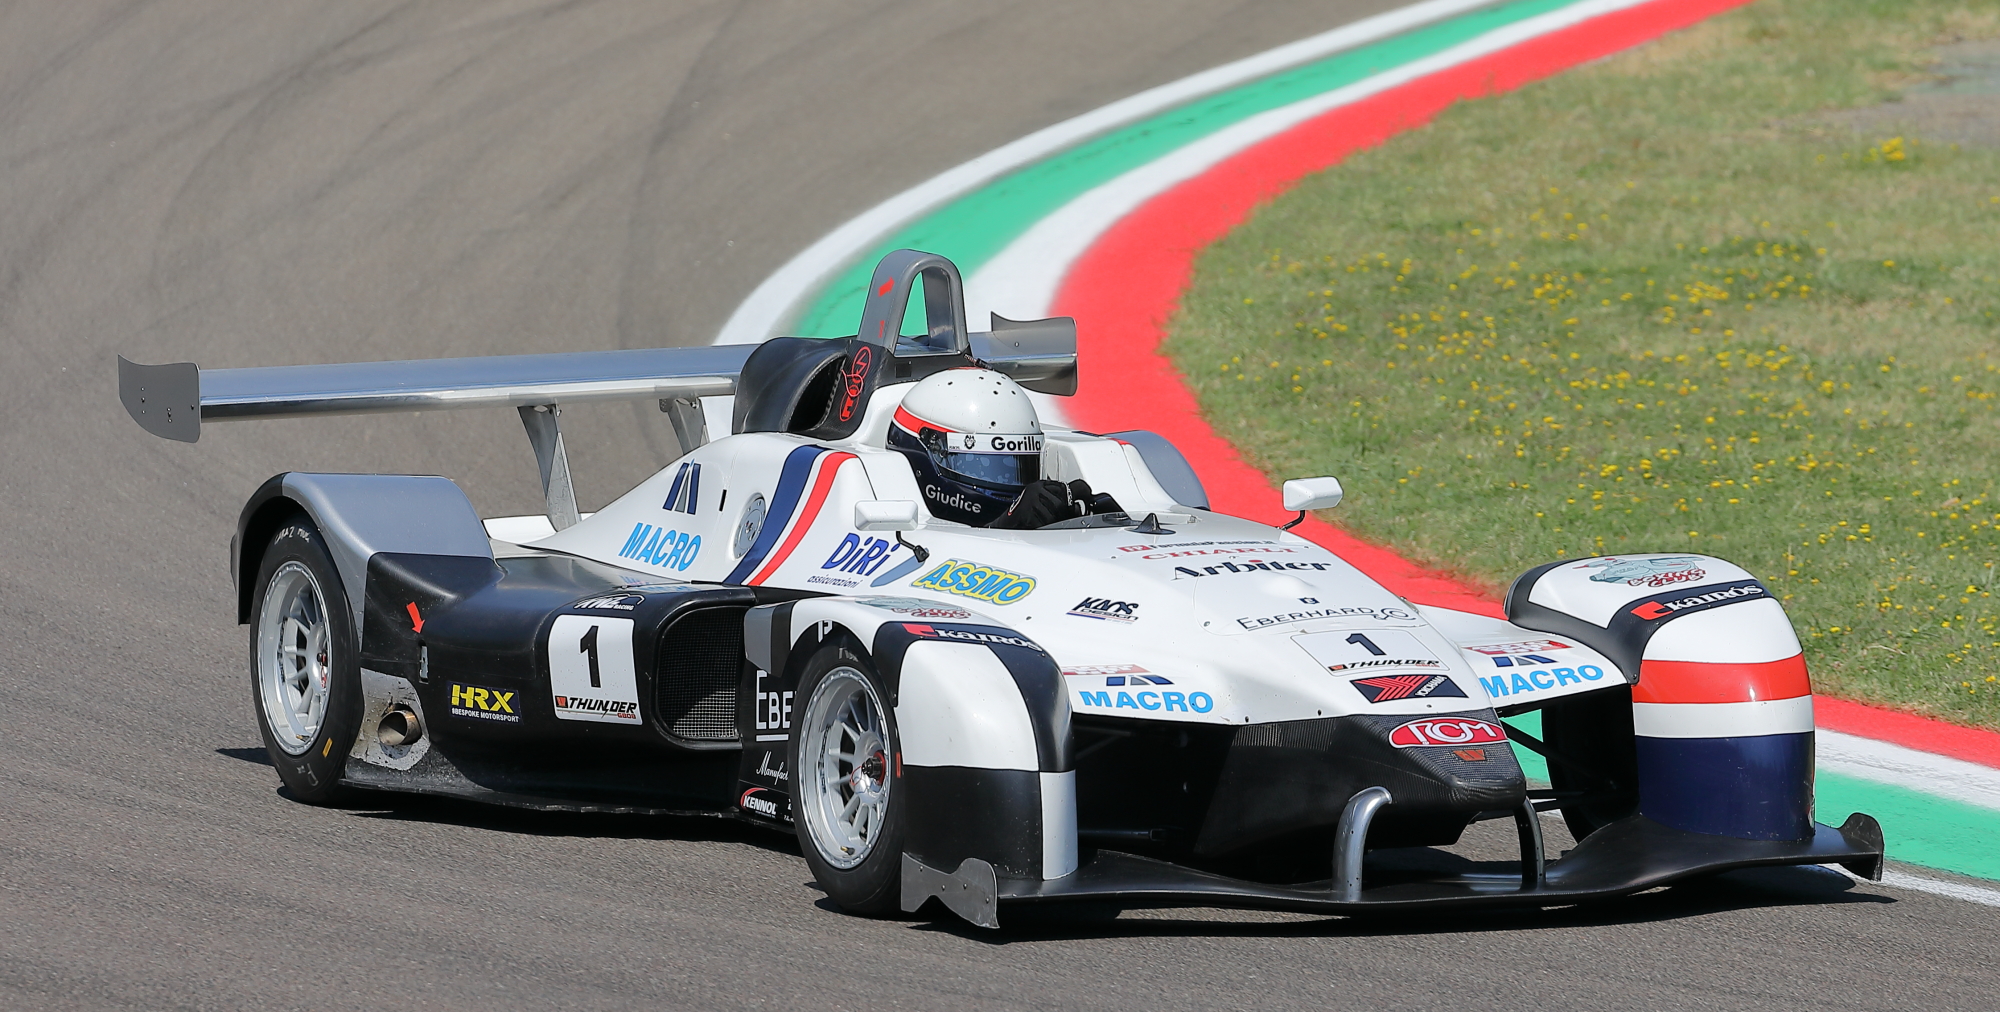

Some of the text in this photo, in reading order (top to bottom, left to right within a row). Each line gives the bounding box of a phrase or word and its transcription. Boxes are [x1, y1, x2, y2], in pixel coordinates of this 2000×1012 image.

[991, 436, 1042, 451] Gorilla
[925, 484, 982, 514] Giudice
[618, 522, 702, 571] MACRO
[1170, 559, 1332, 581] Arbiter
[914, 559, 1036, 604] ASSMO
[1071, 597, 1140, 615] KAOS
[1236, 607, 1376, 632] EBERHARD
[1344, 633, 1387, 656] 1
[580, 625, 601, 688] 1
[1348, 659, 1440, 669] THUNDER
[1414, 675, 1448, 697] YOKOHAMA
[1478, 664, 1604, 698] MACRO
[452, 684, 514, 714] HRX
[569, 697, 637, 715] THUNDER
[756, 670, 797, 730] EBE
[1078, 691, 1214, 713] MACRO
[480, 711, 519, 723] MOTORSPORT
[743, 795, 777, 815] KENNOL
